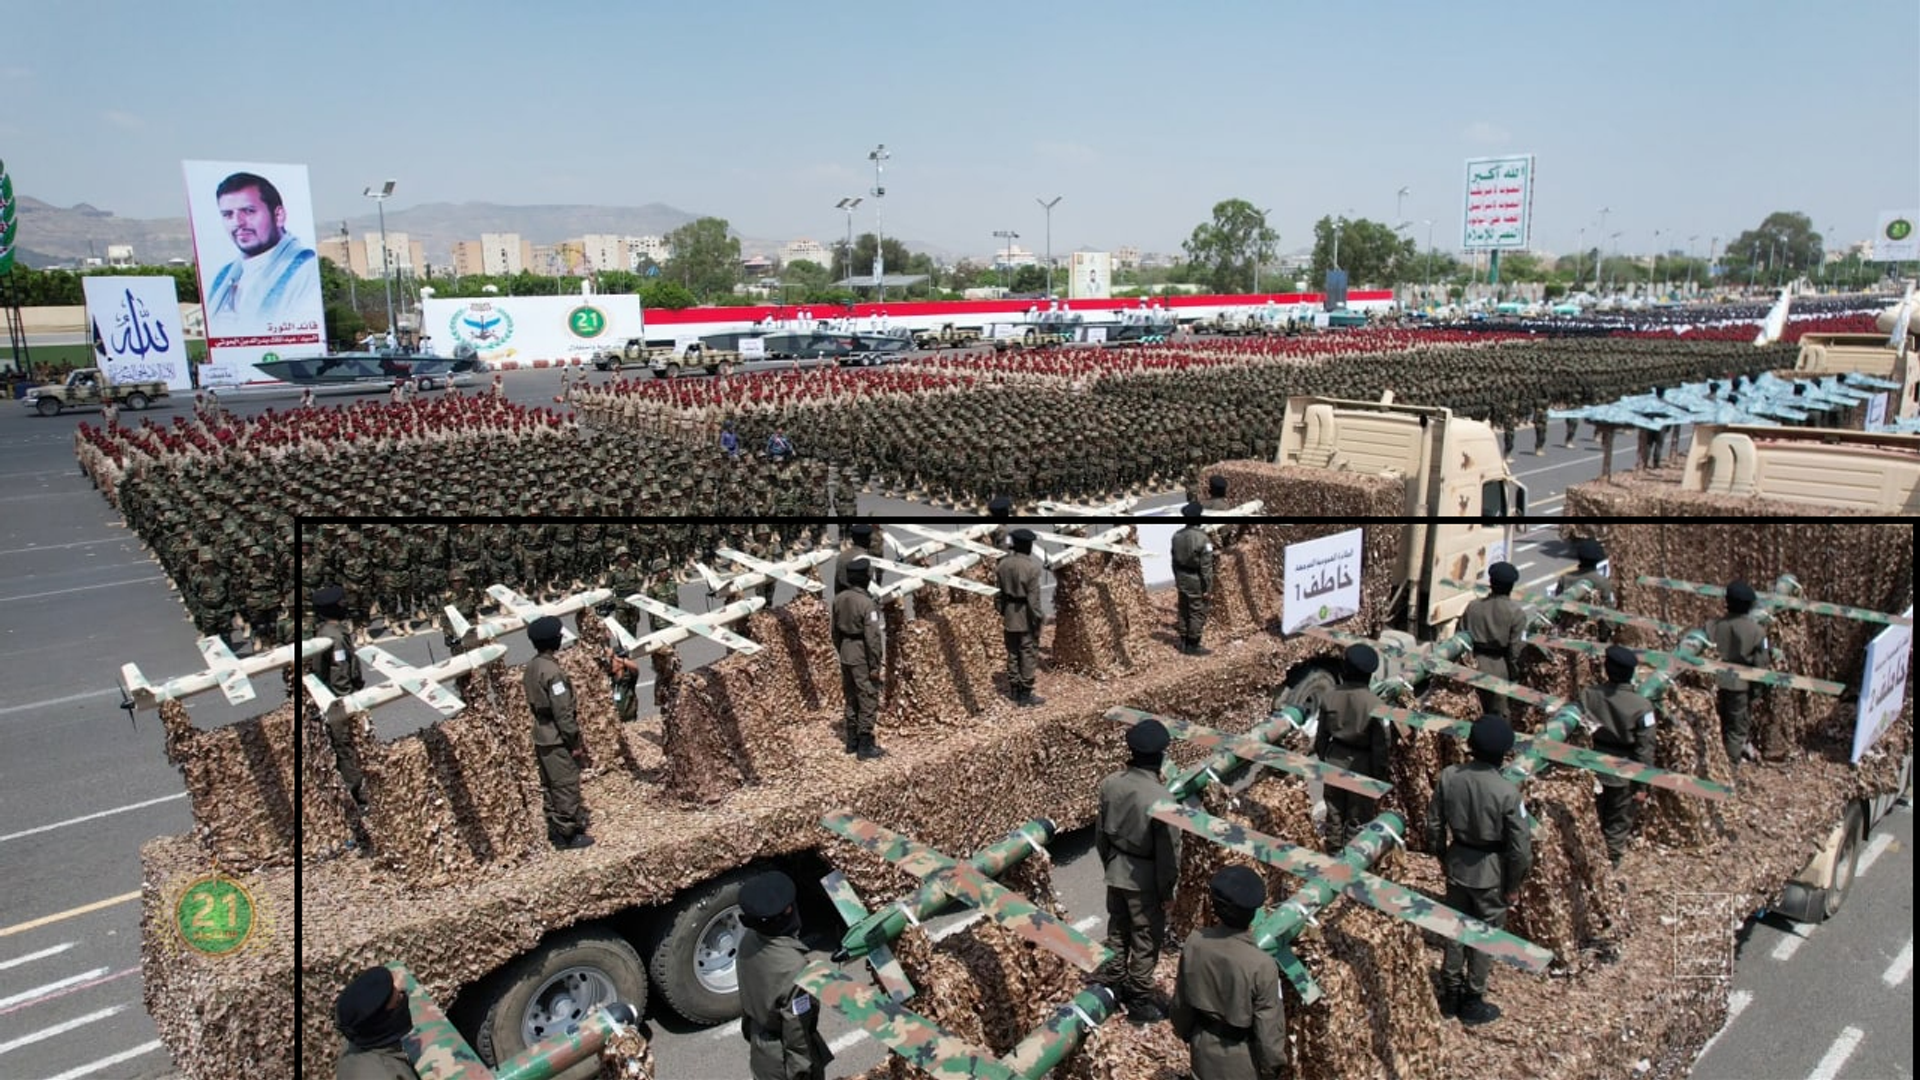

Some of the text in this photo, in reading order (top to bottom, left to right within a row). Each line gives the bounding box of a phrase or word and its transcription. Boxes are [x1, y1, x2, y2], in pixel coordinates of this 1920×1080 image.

[1504, 165, 1526, 178] الله
[576, 312, 598, 327] 21
[1294, 564, 1353, 601] خاطف 1
